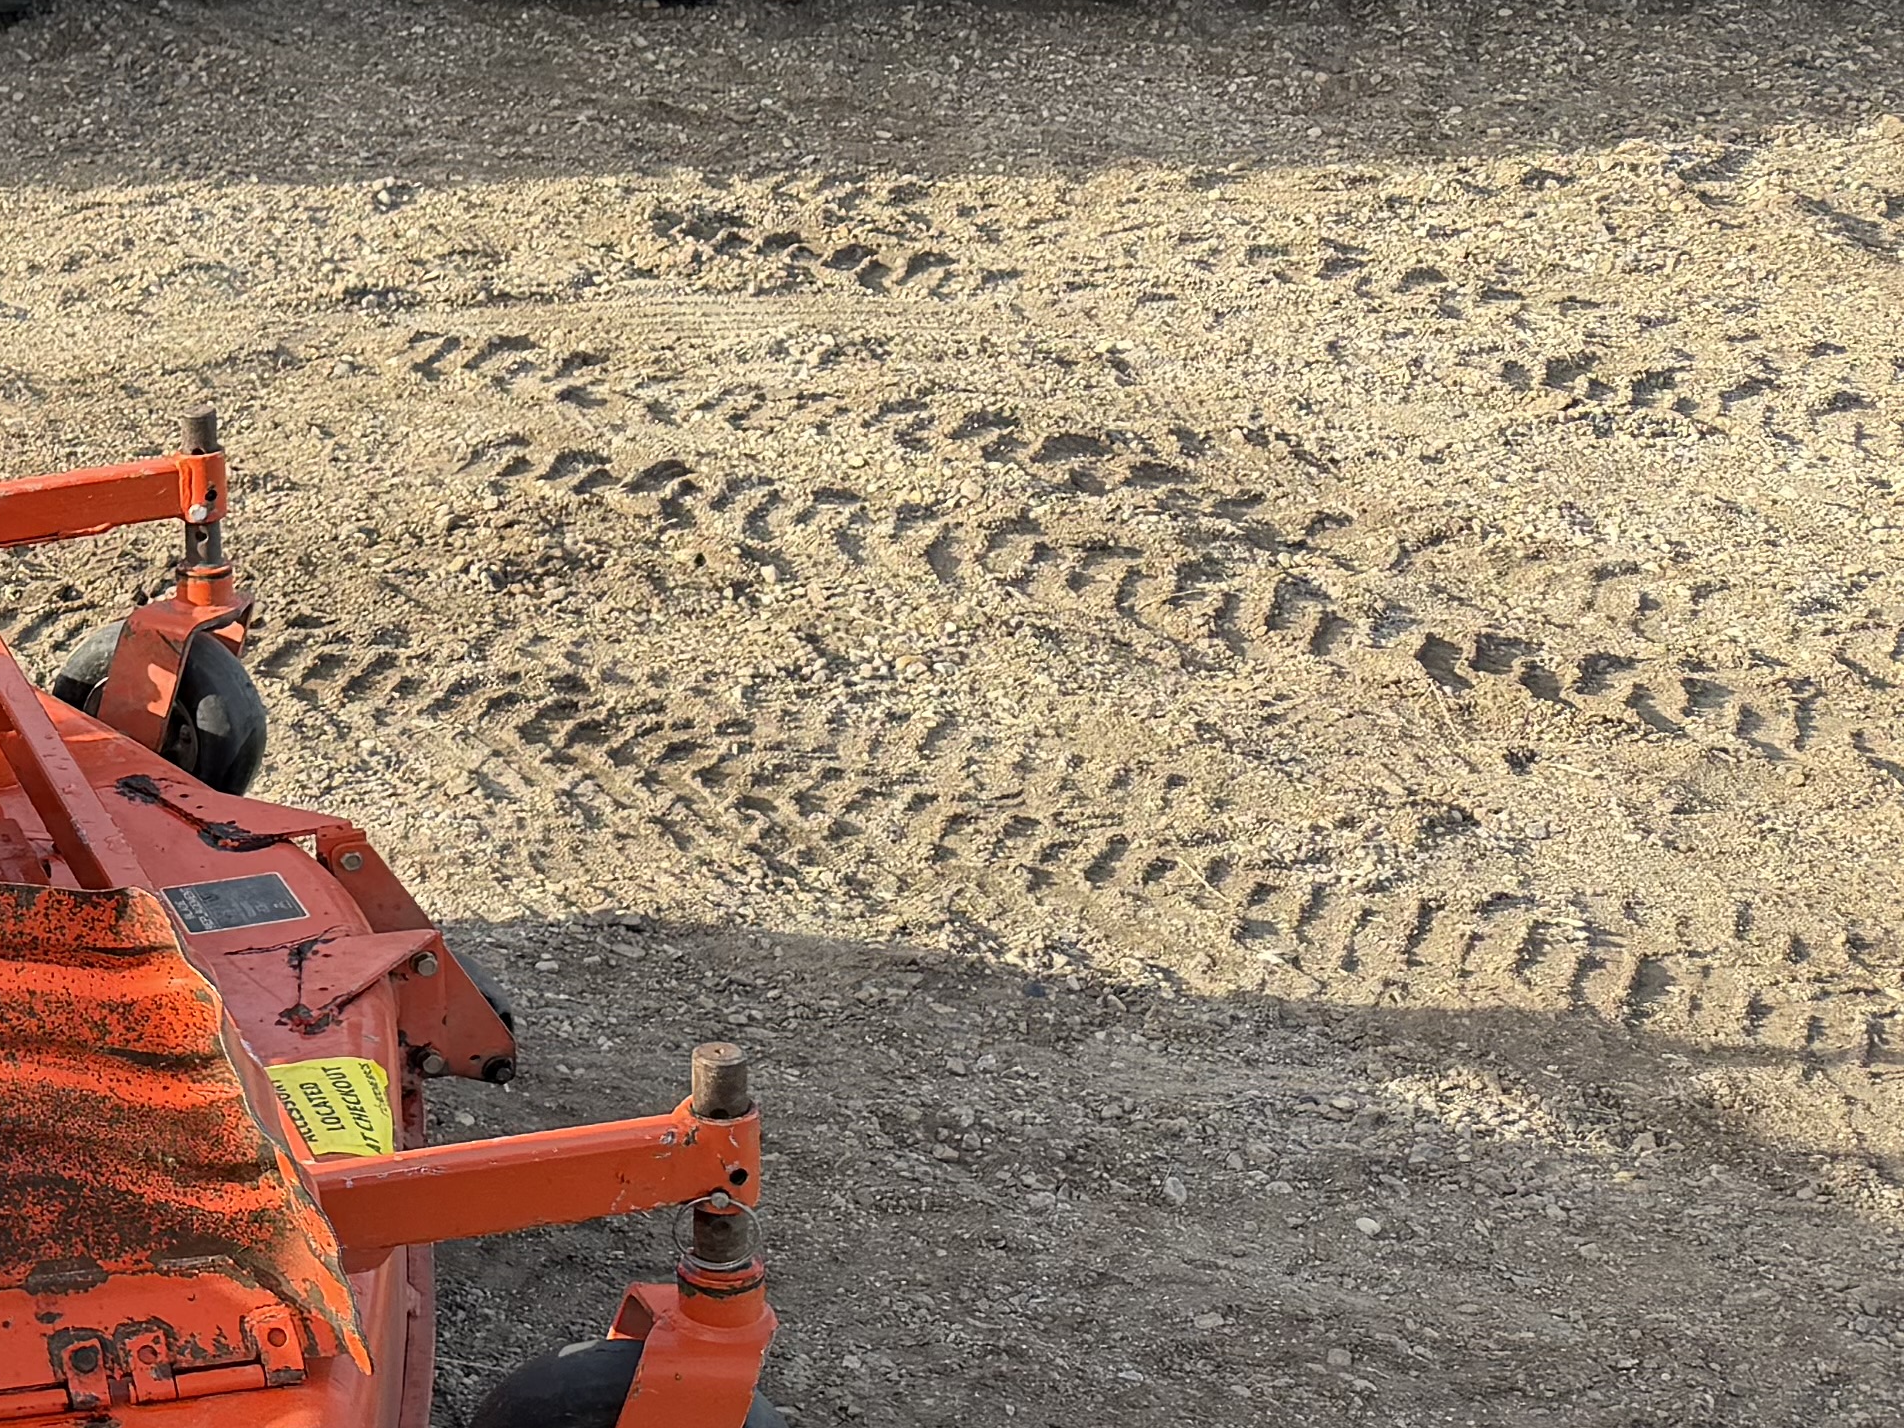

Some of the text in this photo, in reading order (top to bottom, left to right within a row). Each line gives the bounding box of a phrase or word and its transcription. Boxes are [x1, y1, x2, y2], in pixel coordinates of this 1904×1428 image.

[299, 1082, 346, 1131] LOCATED
[322, 1067, 373, 1132] CHECKOUT
[360, 1132, 383, 1154] AT
